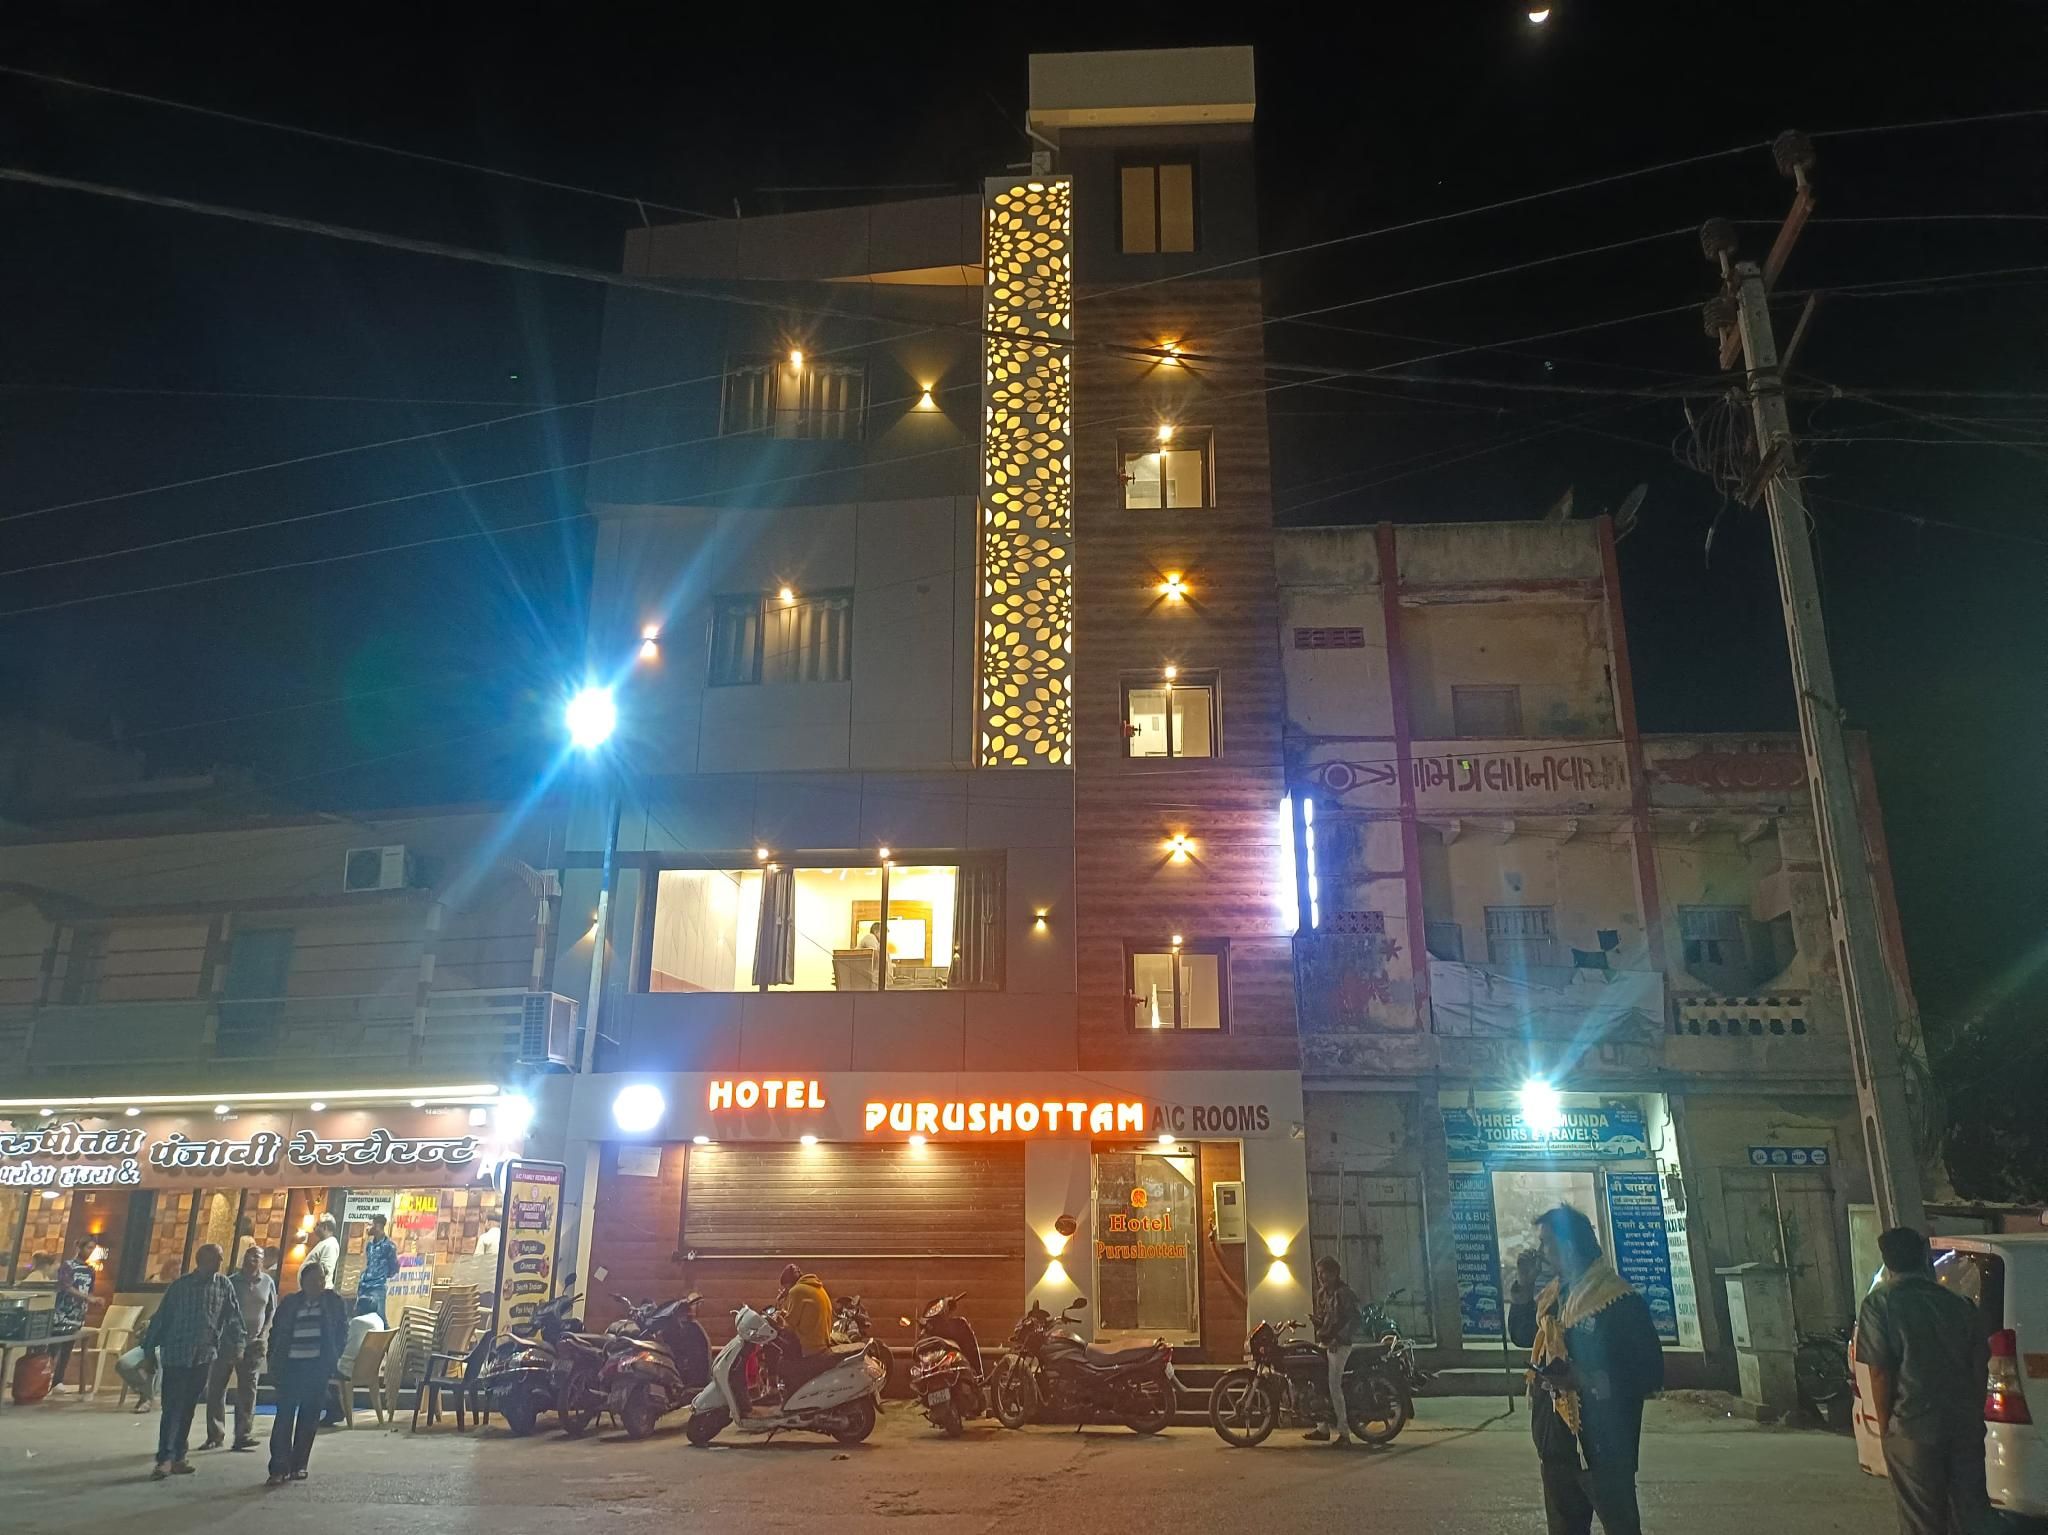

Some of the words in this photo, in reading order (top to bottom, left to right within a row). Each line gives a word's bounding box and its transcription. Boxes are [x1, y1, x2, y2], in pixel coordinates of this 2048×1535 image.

[709, 1080, 825, 1111] HOTEL
[865, 1102, 1144, 1134] PURUSHOTTAM
[1193, 1105, 1270, 1131] ROOMS
[1475, 1113, 1520, 1127] SHREE
[1485, 1128, 1527, 1141] TOURS
[118, 1158, 140, 1184] &
[415, 1195, 437, 1212] HALL
[1109, 1213, 1172, 1232] Hotel
[1473, 1211, 1490, 1221] BUS
[1638, 1221, 1645, 1229] &
